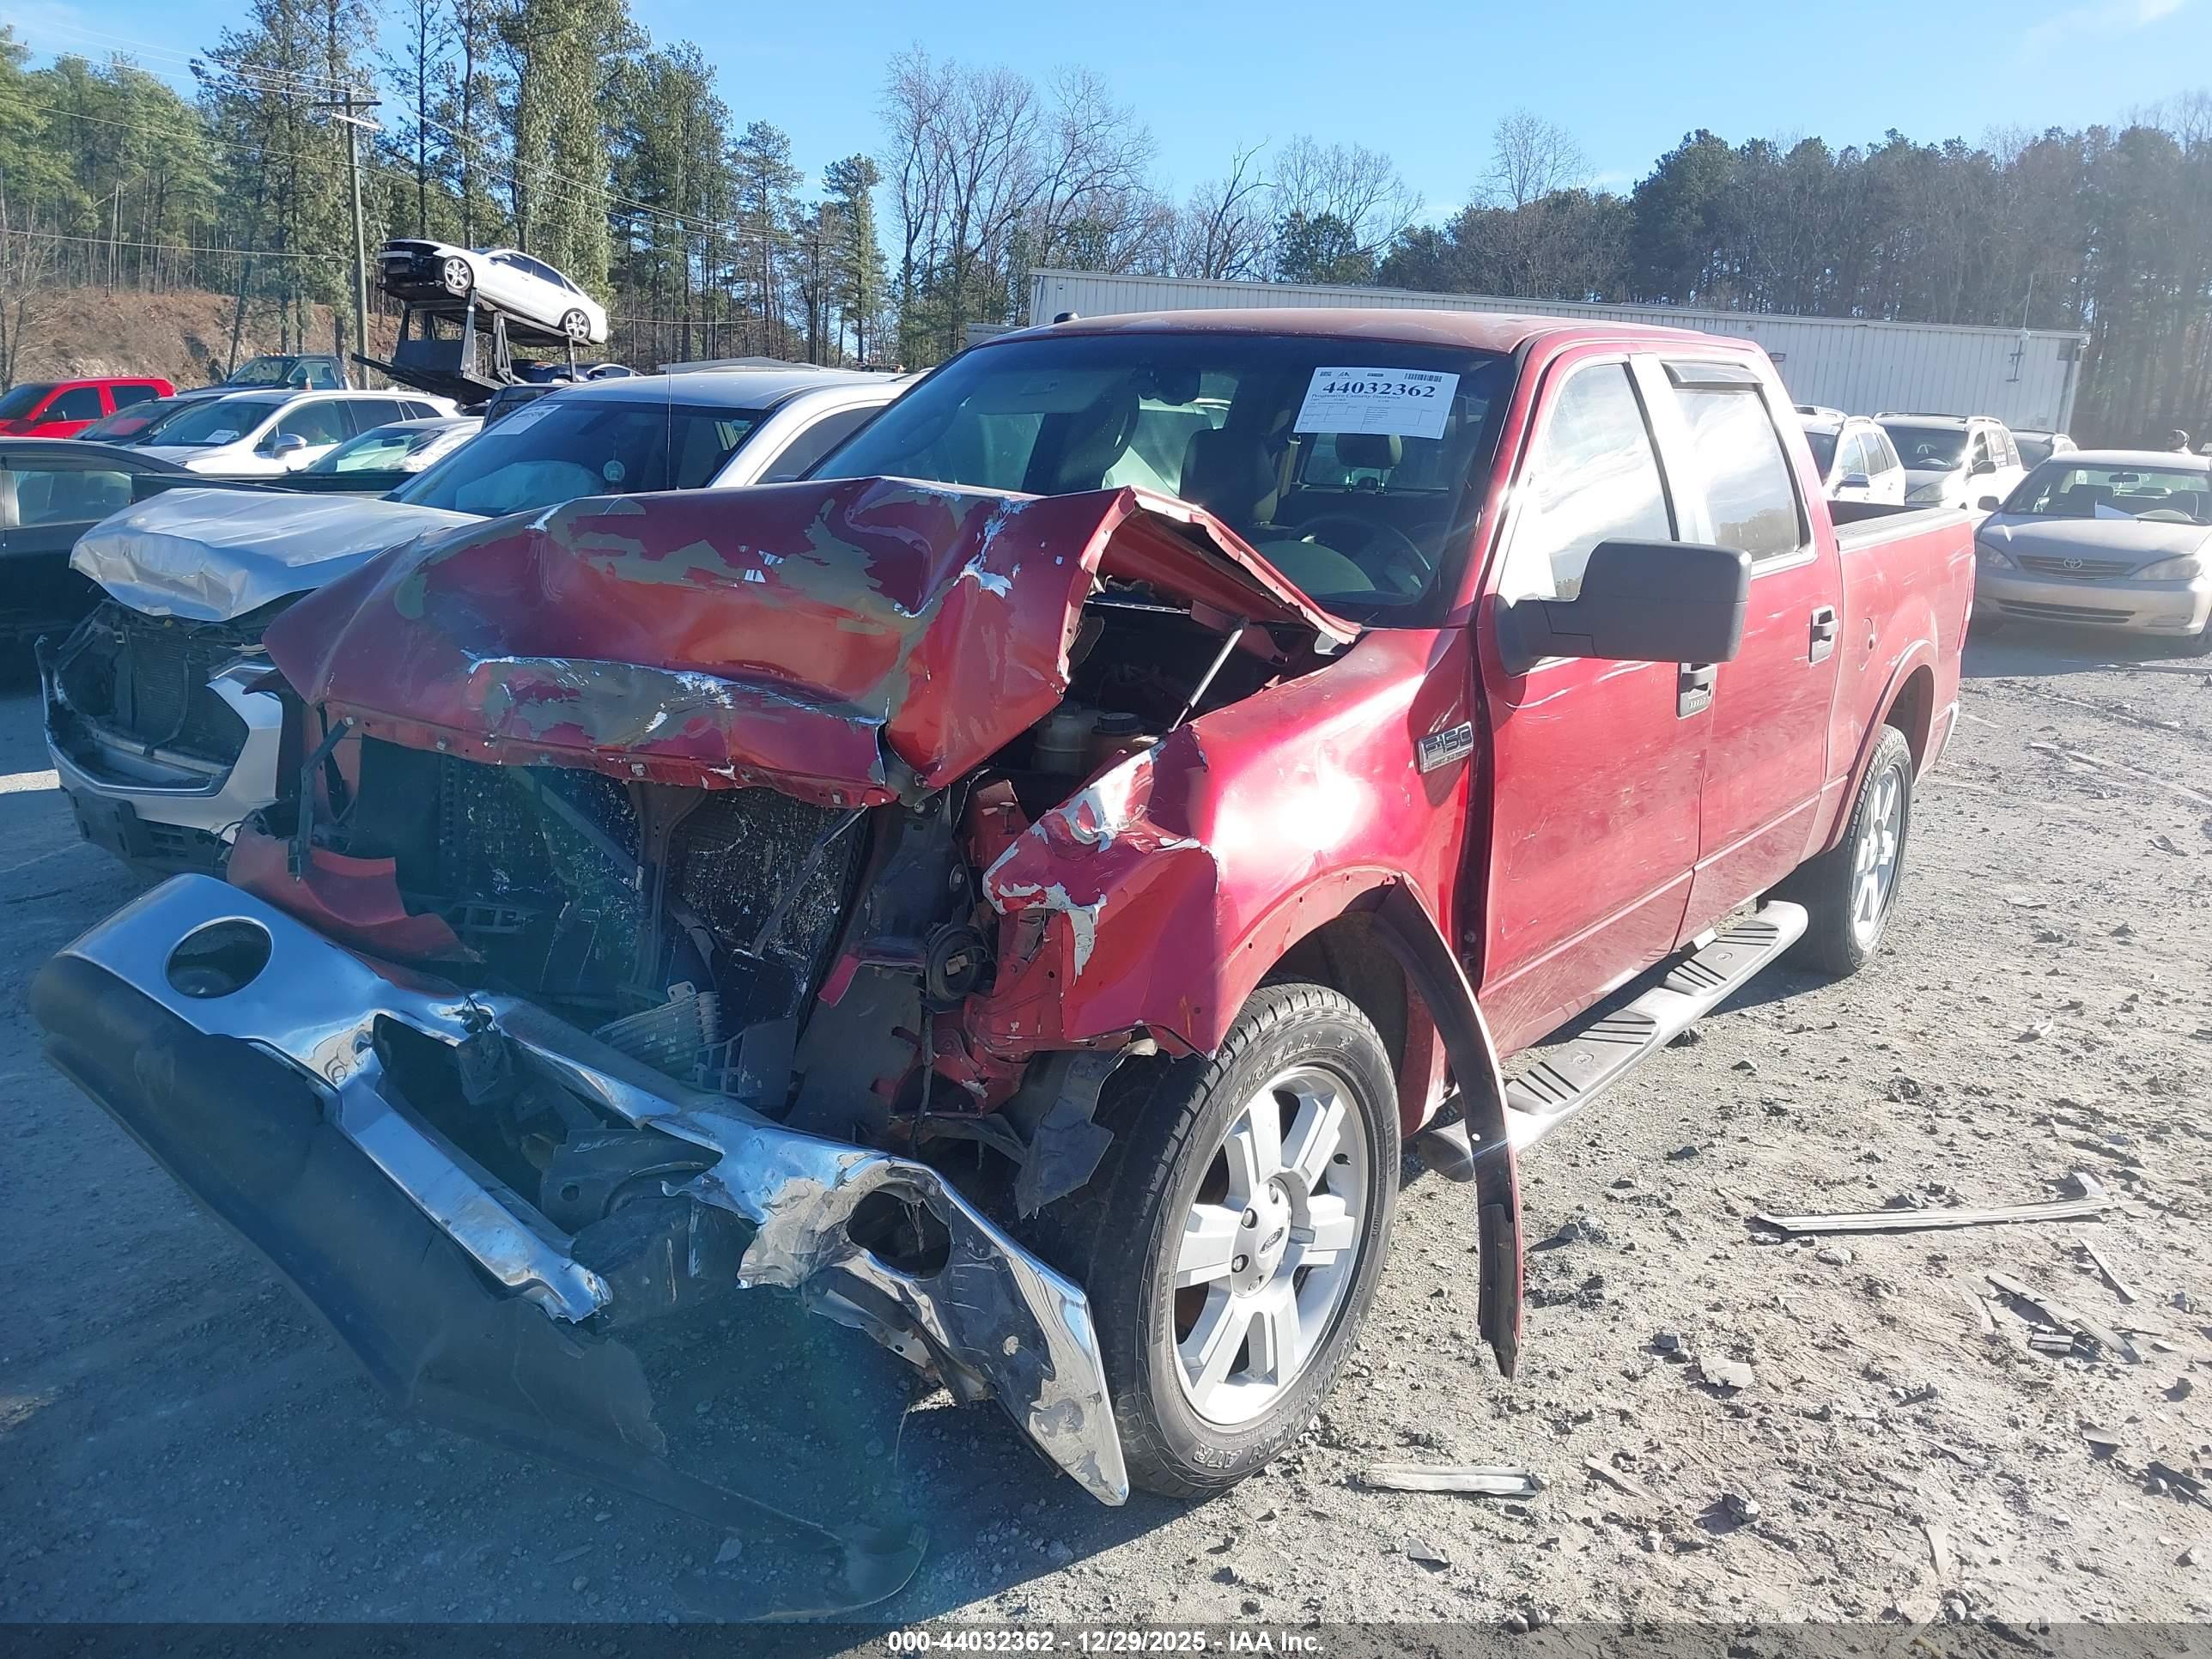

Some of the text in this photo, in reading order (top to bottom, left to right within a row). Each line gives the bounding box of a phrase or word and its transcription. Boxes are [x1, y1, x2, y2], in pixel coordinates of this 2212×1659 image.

[1322, 381, 1436, 398] 44032362
[1226, 1031, 1322, 1121] PIRELLI
[1192, 1312, 1362, 1469] SCORPION ATR
